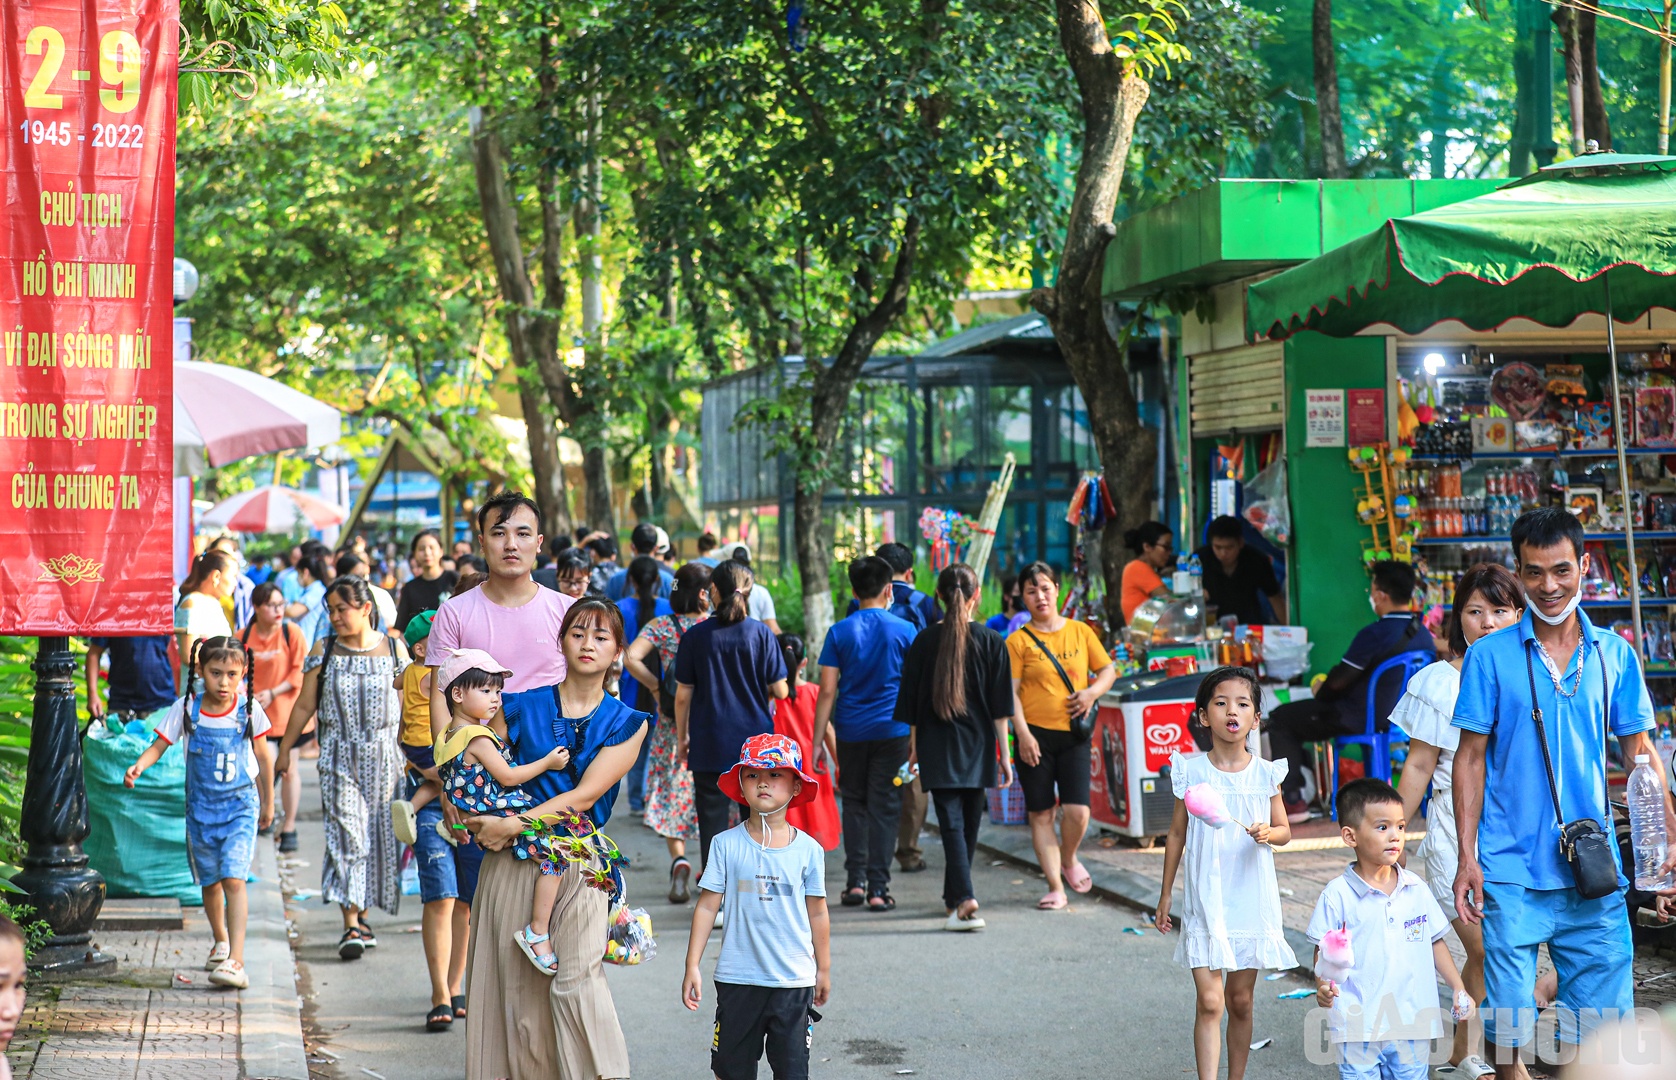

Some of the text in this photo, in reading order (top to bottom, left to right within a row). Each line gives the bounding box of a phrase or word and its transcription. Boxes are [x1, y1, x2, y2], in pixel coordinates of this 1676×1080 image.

[20, 119, 71, 146] 1945
[92, 123, 144, 148] 2022
[40, 181, 122, 235] CHỦ TỊCH
[23, 249, 136, 299] HỒ CHÍ MINH
[5, 321, 151, 375] VĨ ĐẠI SỐNG MÃI
[0, 398, 157, 447] TRONG SỰ NGHIỆP
[11, 461, 141, 510] CỦA CHÚNG TA
[213, 753, 237, 783] 5
